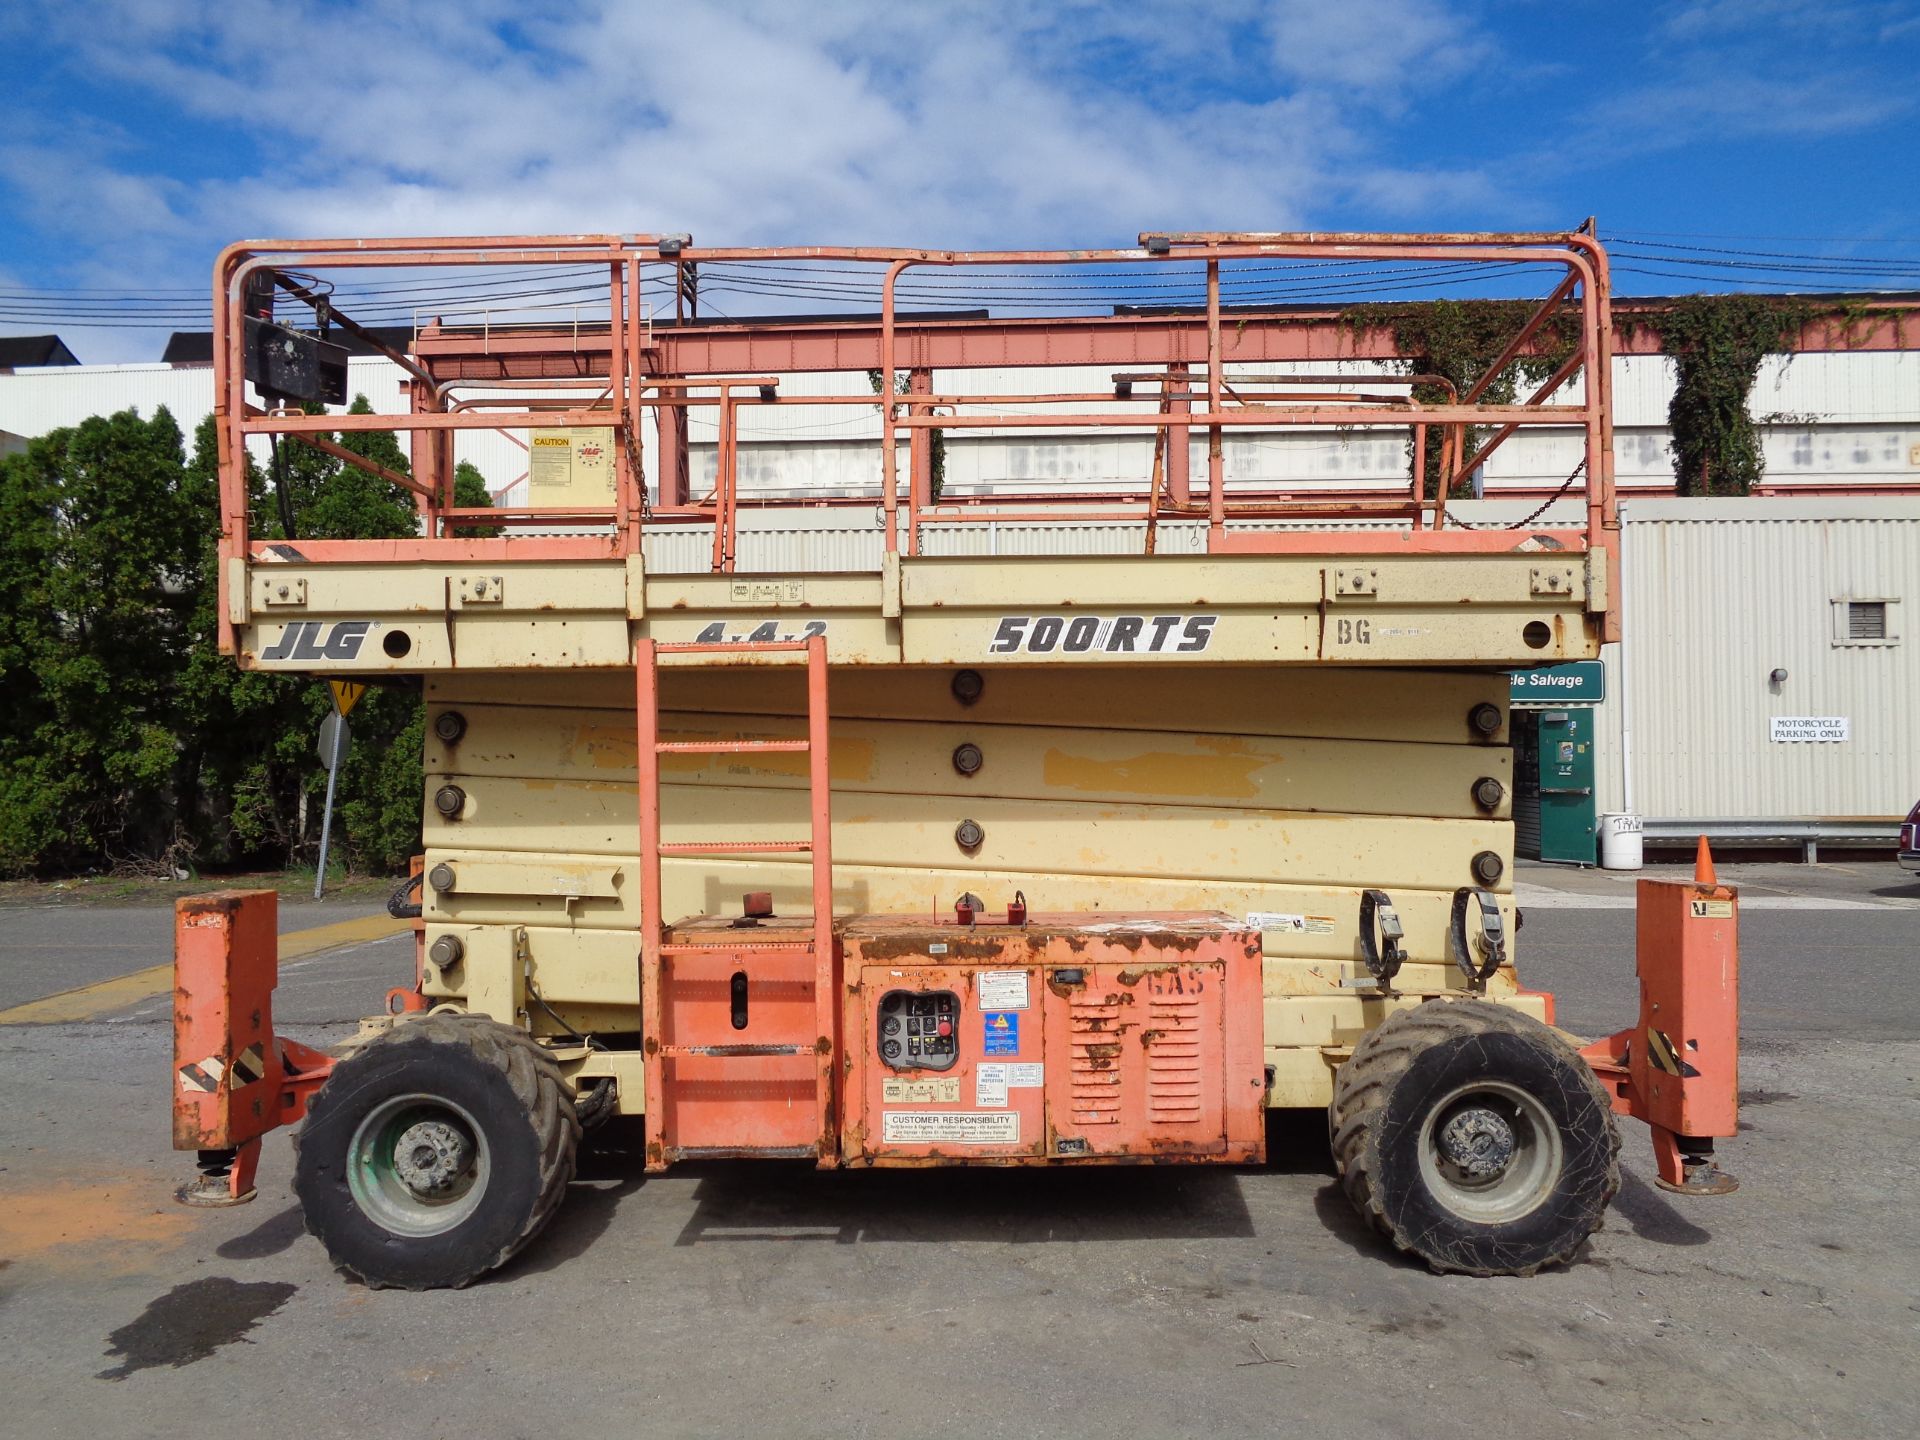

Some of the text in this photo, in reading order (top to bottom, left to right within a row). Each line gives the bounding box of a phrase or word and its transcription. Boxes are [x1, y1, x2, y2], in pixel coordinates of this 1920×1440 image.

[534, 438, 569, 446] CAUTION
[582, 447, 600, 455] JLG
[1338, 619, 1370, 645] BG
[260, 621, 371, 660] JLG
[1529, 674, 1583, 689] Salvage
[1777, 719, 1841, 728] MOTORCYCLE
[1775, 729, 1845, 738] PARKING ONLY
[1147, 969, 1204, 995] GAS
[892, 1116, 1010, 1124] CUSTOMER RESPONSIBILITY
